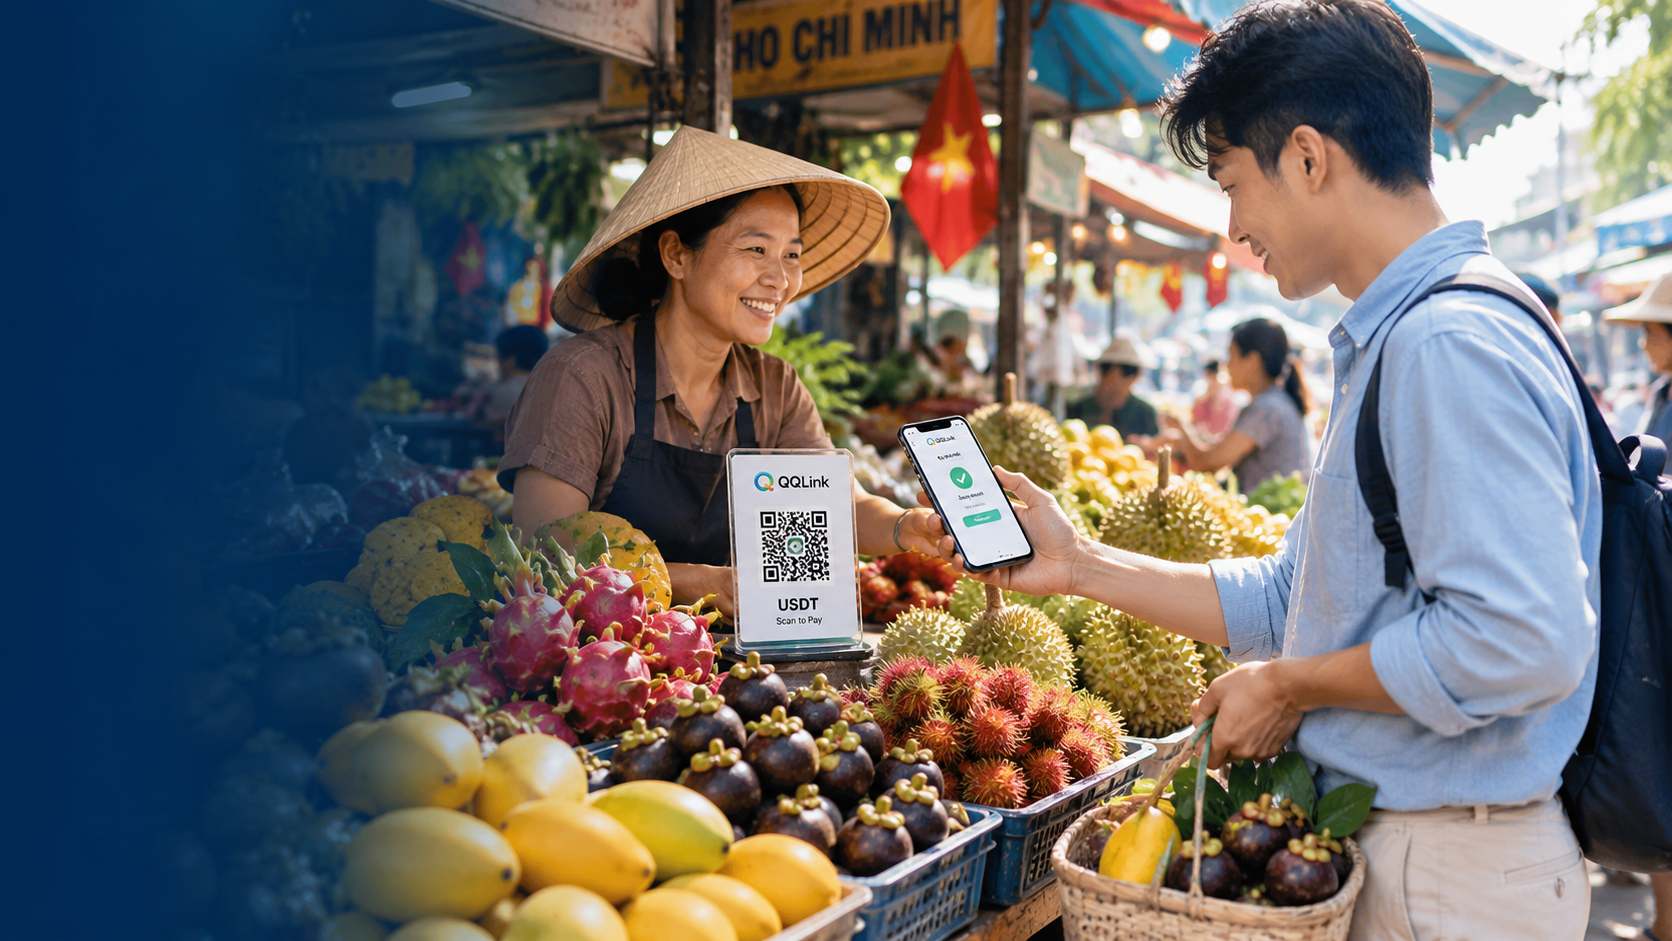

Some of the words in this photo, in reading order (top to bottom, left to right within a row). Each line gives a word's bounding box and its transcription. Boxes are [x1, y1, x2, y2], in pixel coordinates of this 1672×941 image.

[734, 26, 779, 71] HO
[793, 14, 849, 62] CHI
[865, 0, 960, 51] MINH
[778, 475, 829, 488] QQLink
[778, 597, 818, 611] USDT
[776, 617, 796, 625] Scan
[808, 616, 822, 625] Pay
